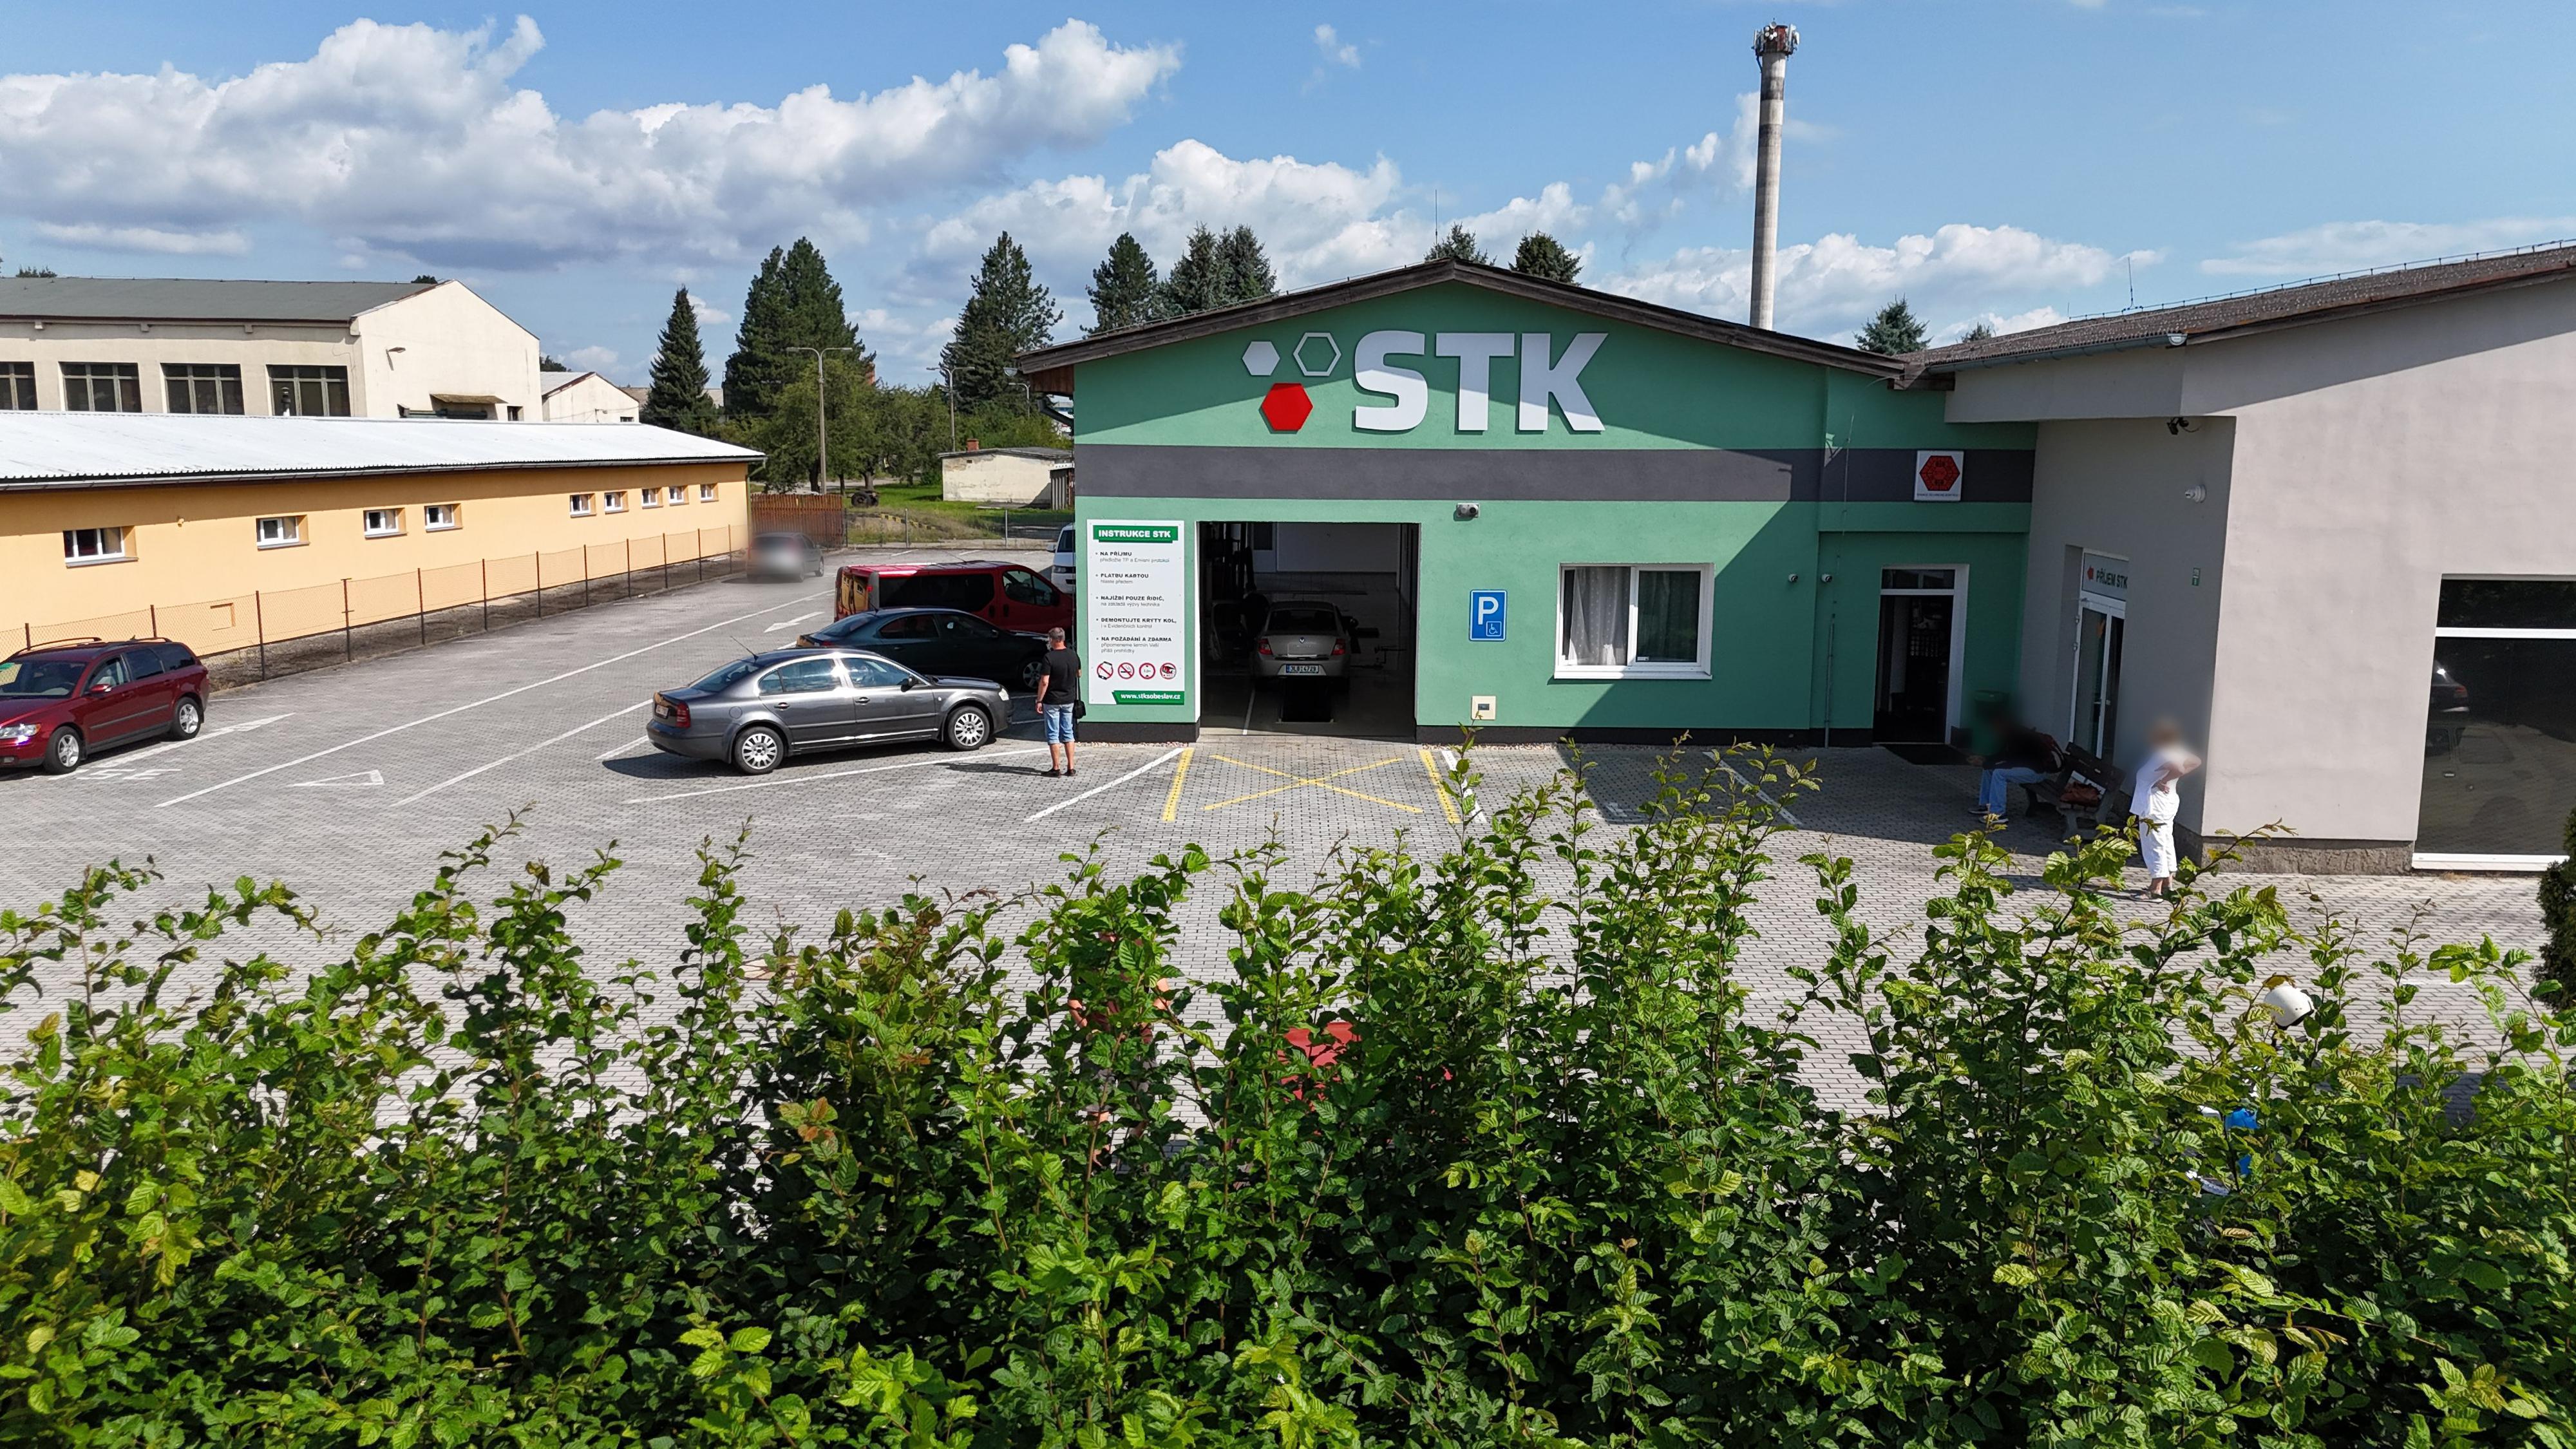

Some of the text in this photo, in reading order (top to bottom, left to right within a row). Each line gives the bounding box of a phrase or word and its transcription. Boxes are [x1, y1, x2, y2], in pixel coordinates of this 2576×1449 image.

[1354, 330, 1609, 431] STK
[1099, 529, 1151, 538] INSTRUKCE
[2096, 567, 2128, 589] PŘÍJEM STK
[1478, 596, 1499, 625] P
